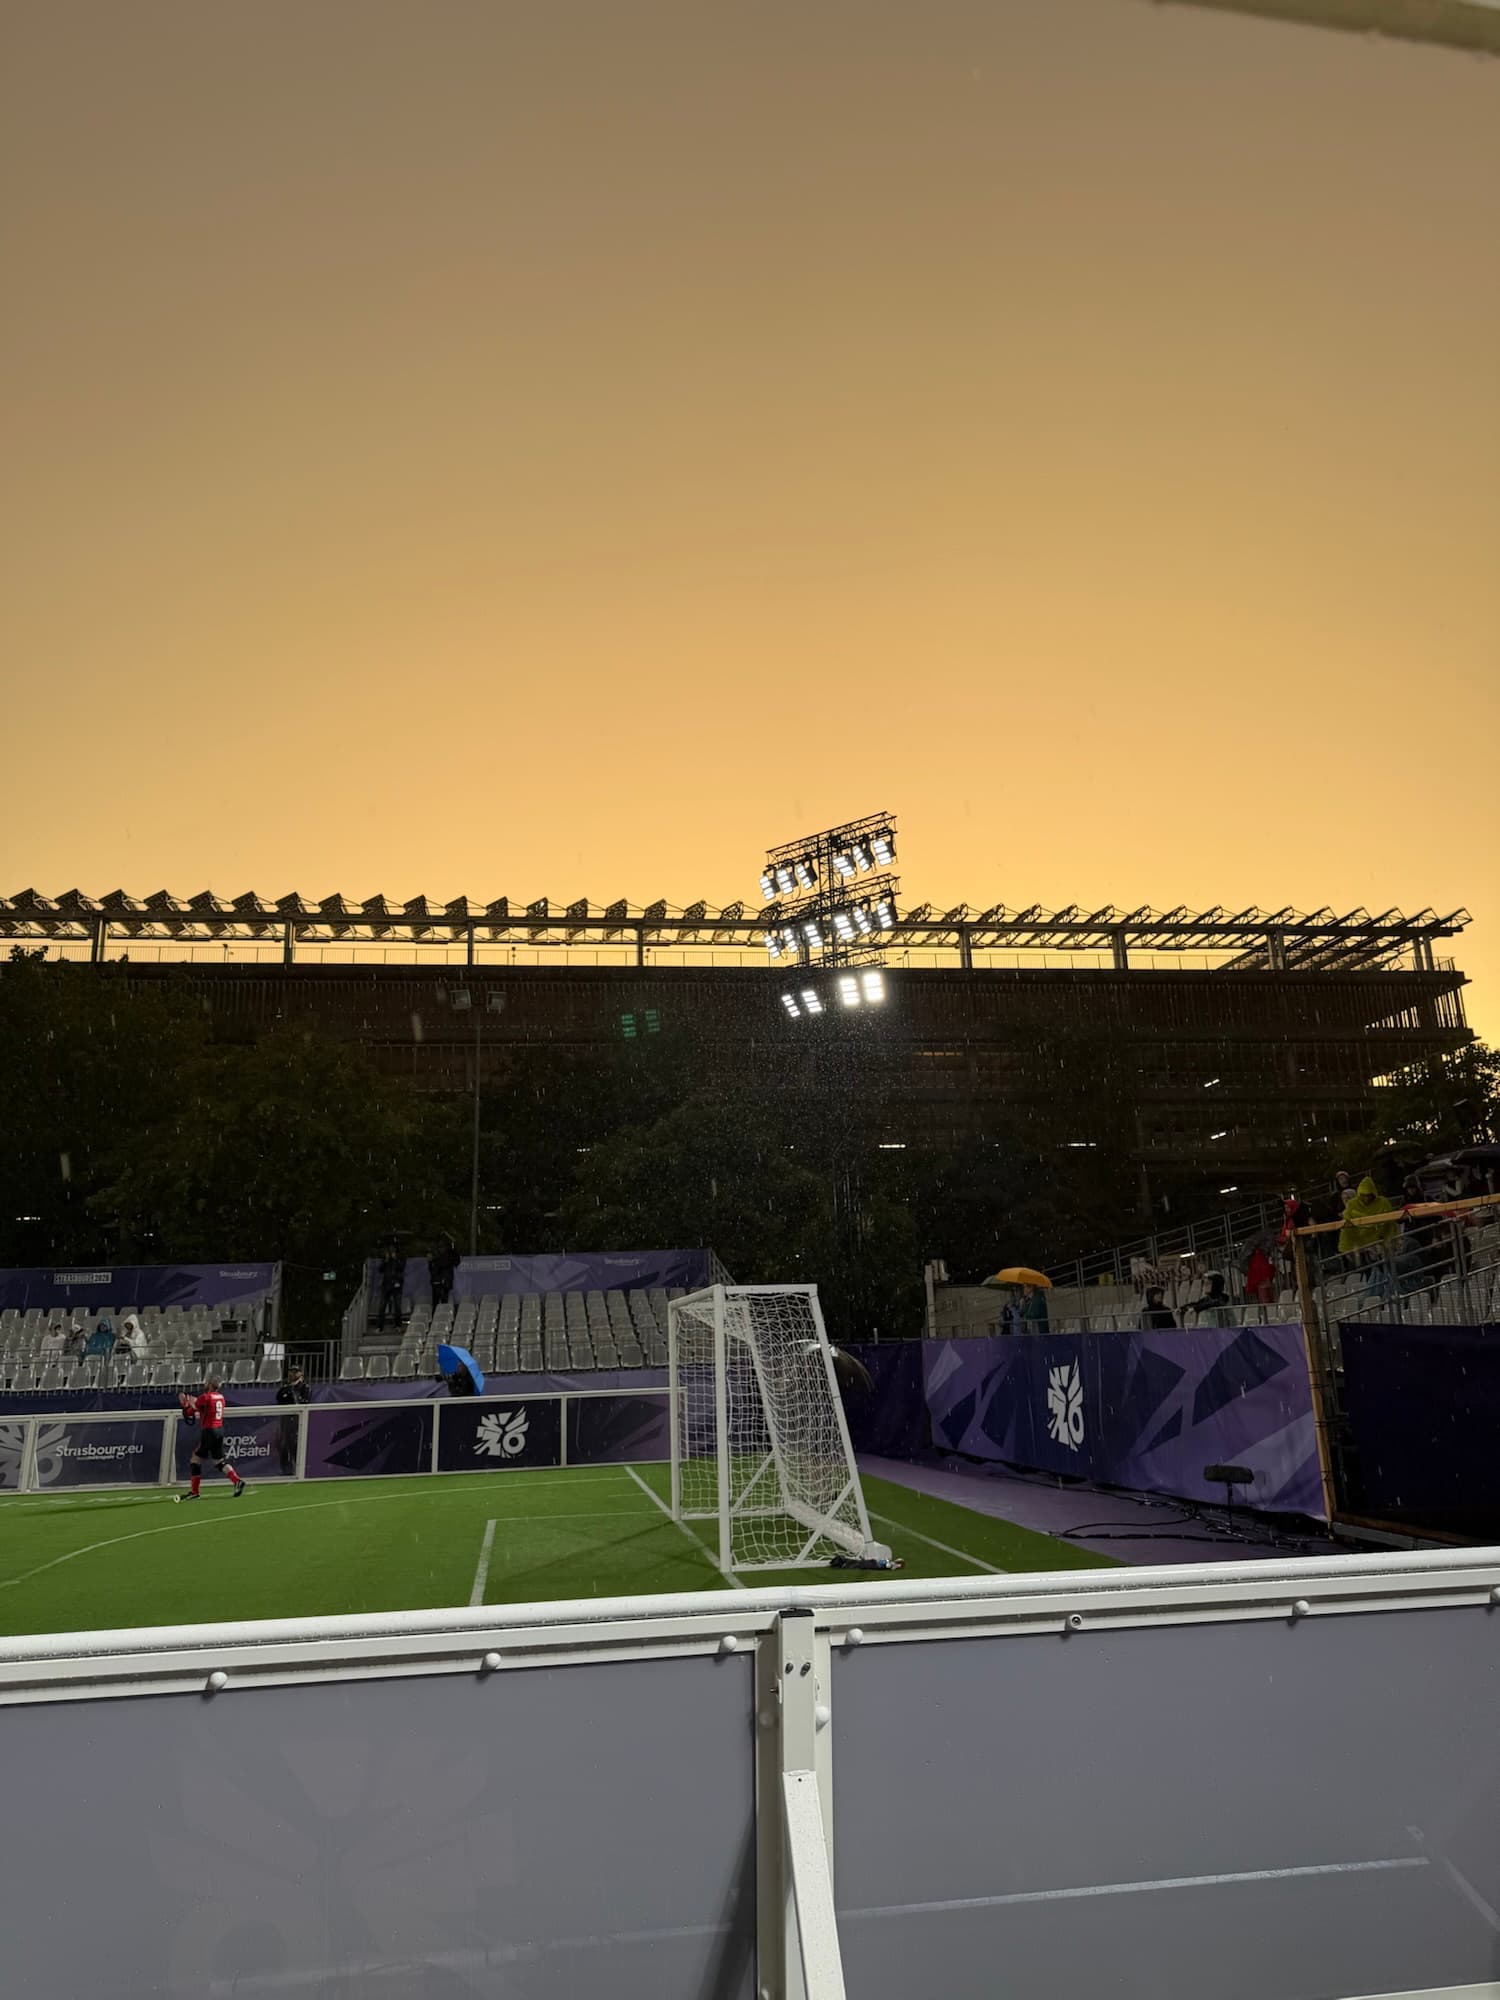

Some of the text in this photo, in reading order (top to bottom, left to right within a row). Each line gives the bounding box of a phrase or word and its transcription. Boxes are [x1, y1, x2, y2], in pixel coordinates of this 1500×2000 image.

[215, 1400, 223, 1420] 9
[55, 1443, 144, 1459] Strasbourg.eu
[225, 1443, 271, 1459] Alsatel
